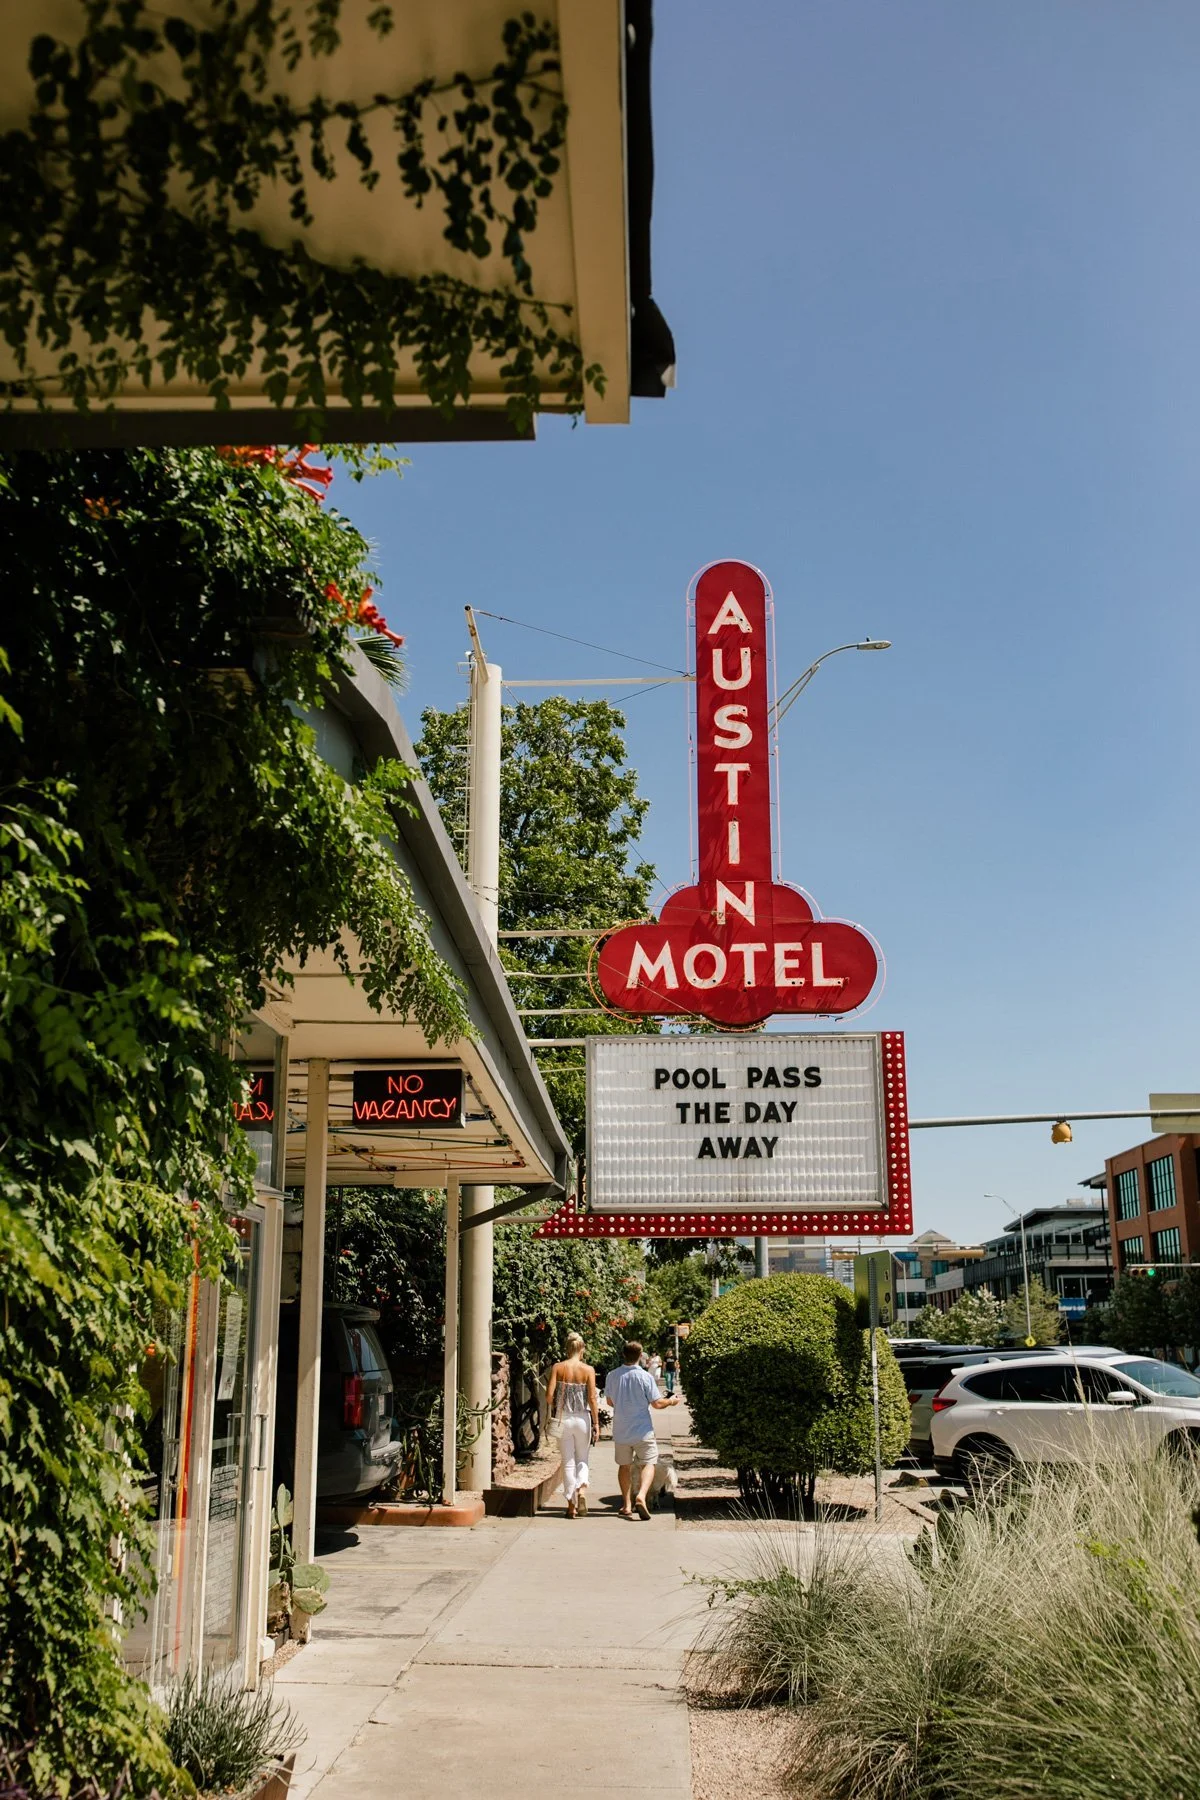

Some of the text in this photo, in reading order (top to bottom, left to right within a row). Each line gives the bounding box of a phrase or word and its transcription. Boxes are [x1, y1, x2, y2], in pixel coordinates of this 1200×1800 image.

[707, 590, 755, 926] AUSTIN
[625, 940, 845, 989] MOTEL
[387, 1075, 424, 1094] NO
[655, 1066, 822, 1089] POOL PASS
[353, 1097, 457, 1120] VACANCY
[676, 1101, 797, 1124] THE DAY
[698, 1136, 778, 1159] AWAY
